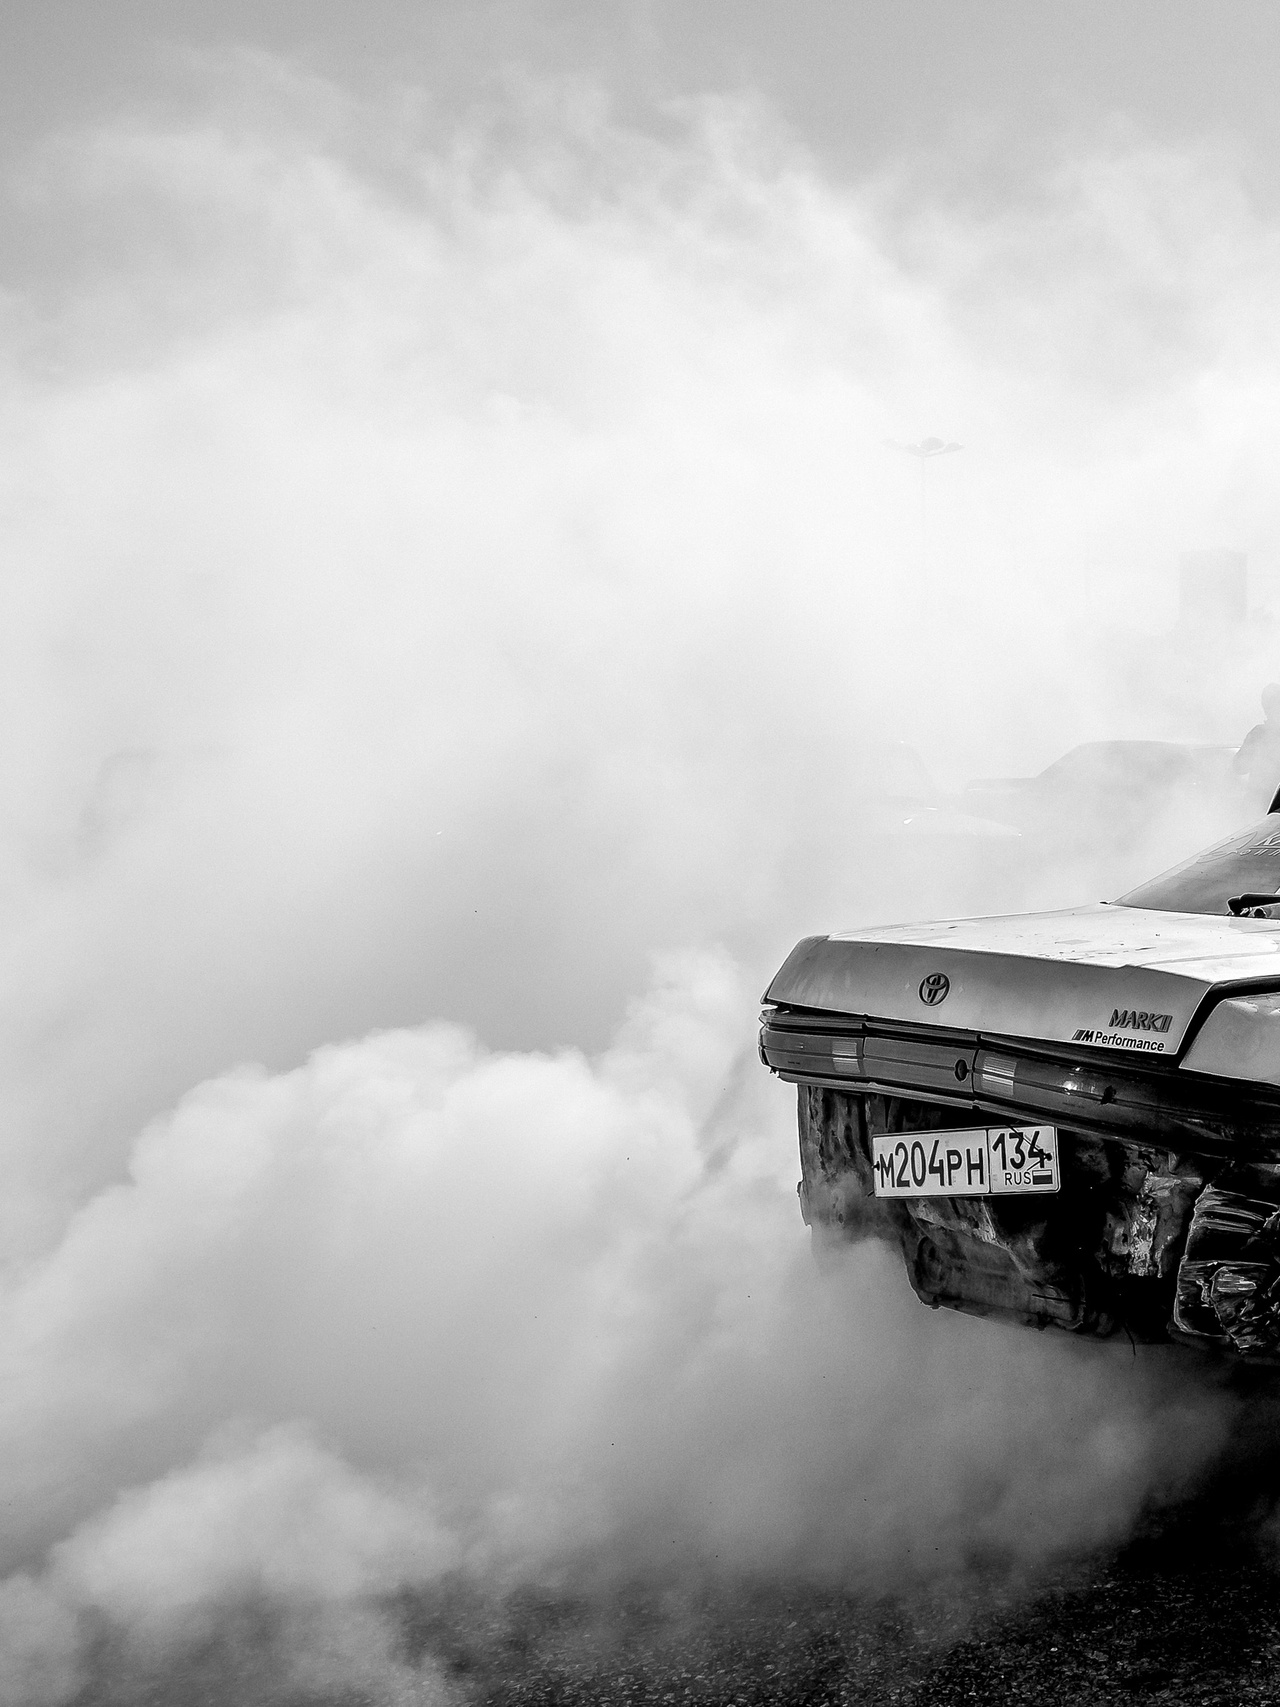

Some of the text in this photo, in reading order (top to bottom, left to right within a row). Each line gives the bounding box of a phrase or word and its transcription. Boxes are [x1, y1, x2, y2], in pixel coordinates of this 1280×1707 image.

[1094, 1031, 1165, 1052] Performance
[991, 1130, 1048, 1171] 134
[1004, 1171, 1032, 1186] RUS
